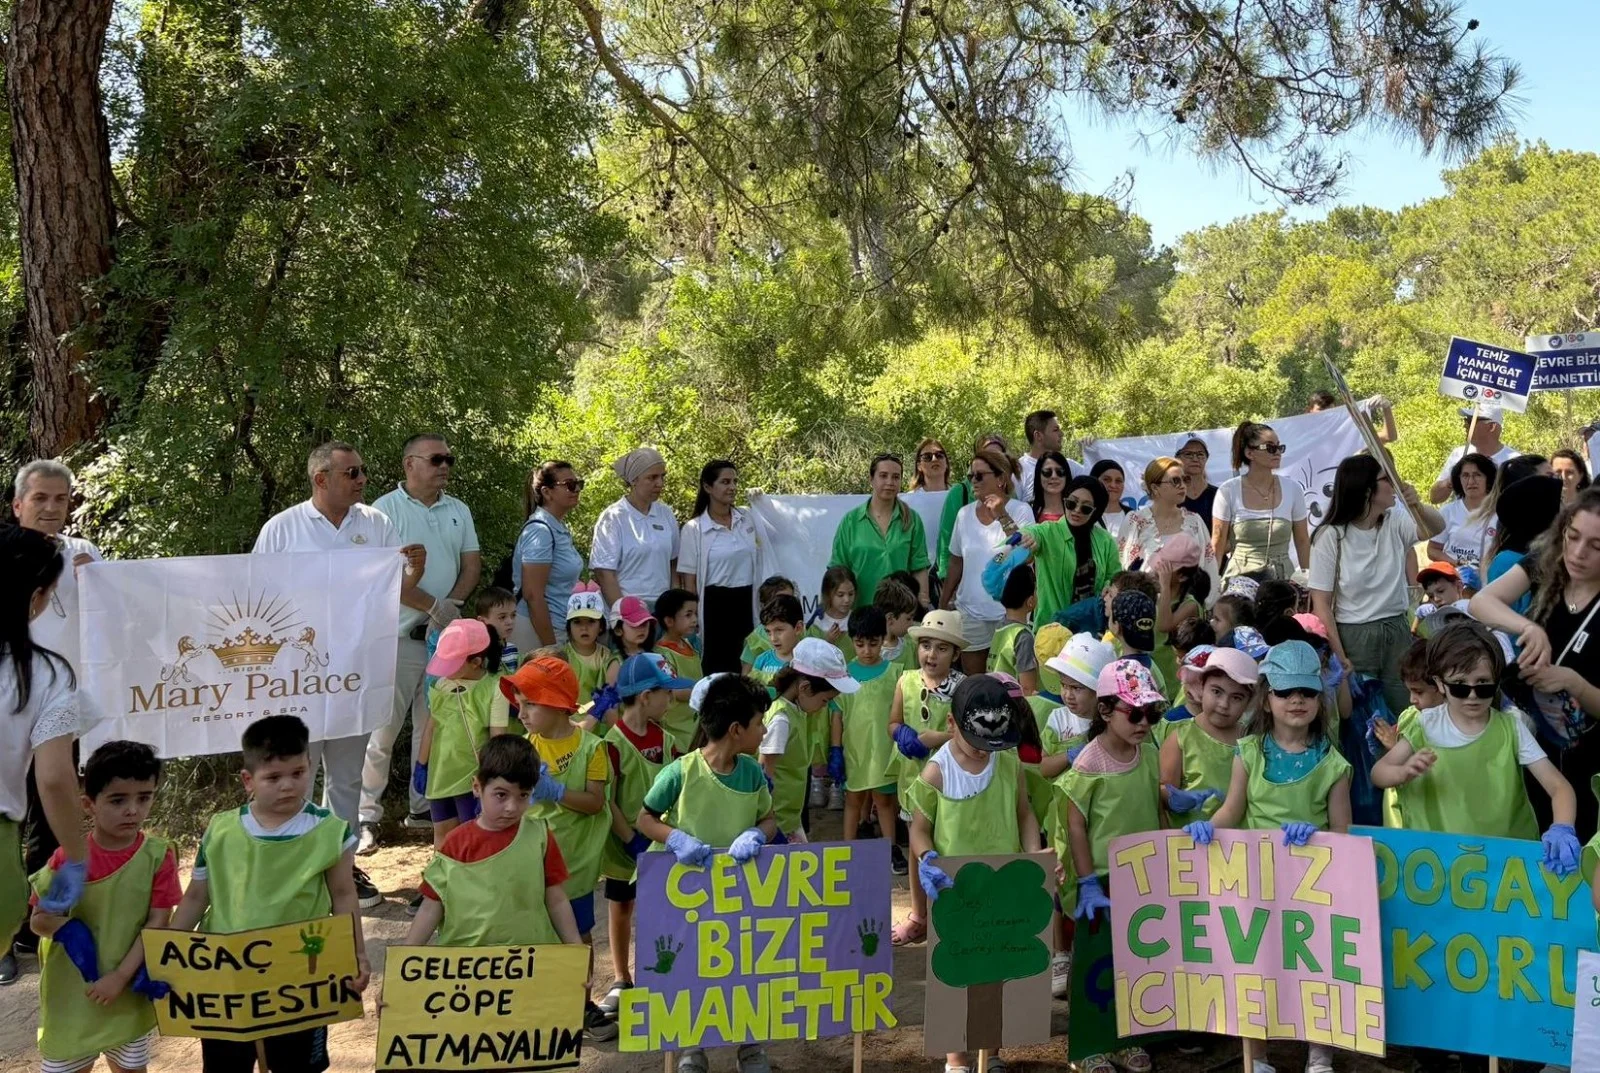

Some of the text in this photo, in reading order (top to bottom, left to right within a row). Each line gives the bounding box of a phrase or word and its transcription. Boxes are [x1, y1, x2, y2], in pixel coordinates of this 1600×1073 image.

[1457, 355, 1523, 378] MANAVGAT
[1476, 347, 1510, 363] TEMİZ
[1576, 352, 1600, 366] BİZ
[1456, 364, 1517, 389] İÇİN EL ELE
[1531, 369, 1600, 385] EMANETTİ
[128, 669, 362, 713] Mary Palace
[192, 710, 254, 723] RESORT
[280, 705, 308, 714] SPA
[665, 846, 852, 923] ÇEVRE
[1115, 833, 1333, 907] TEMİZ
[160, 937, 272, 974] AĞAÇ
[697, 911, 829, 978] BİZE
[400, 947, 536, 982] GELECEĞİ
[169, 974, 363, 1020] NEFESTİR
[424, 984, 514, 1019] ÇÖPE
[618, 968, 898, 1053] EMANETTİR
[384, 1026, 584, 1067] ATMAYALIM
